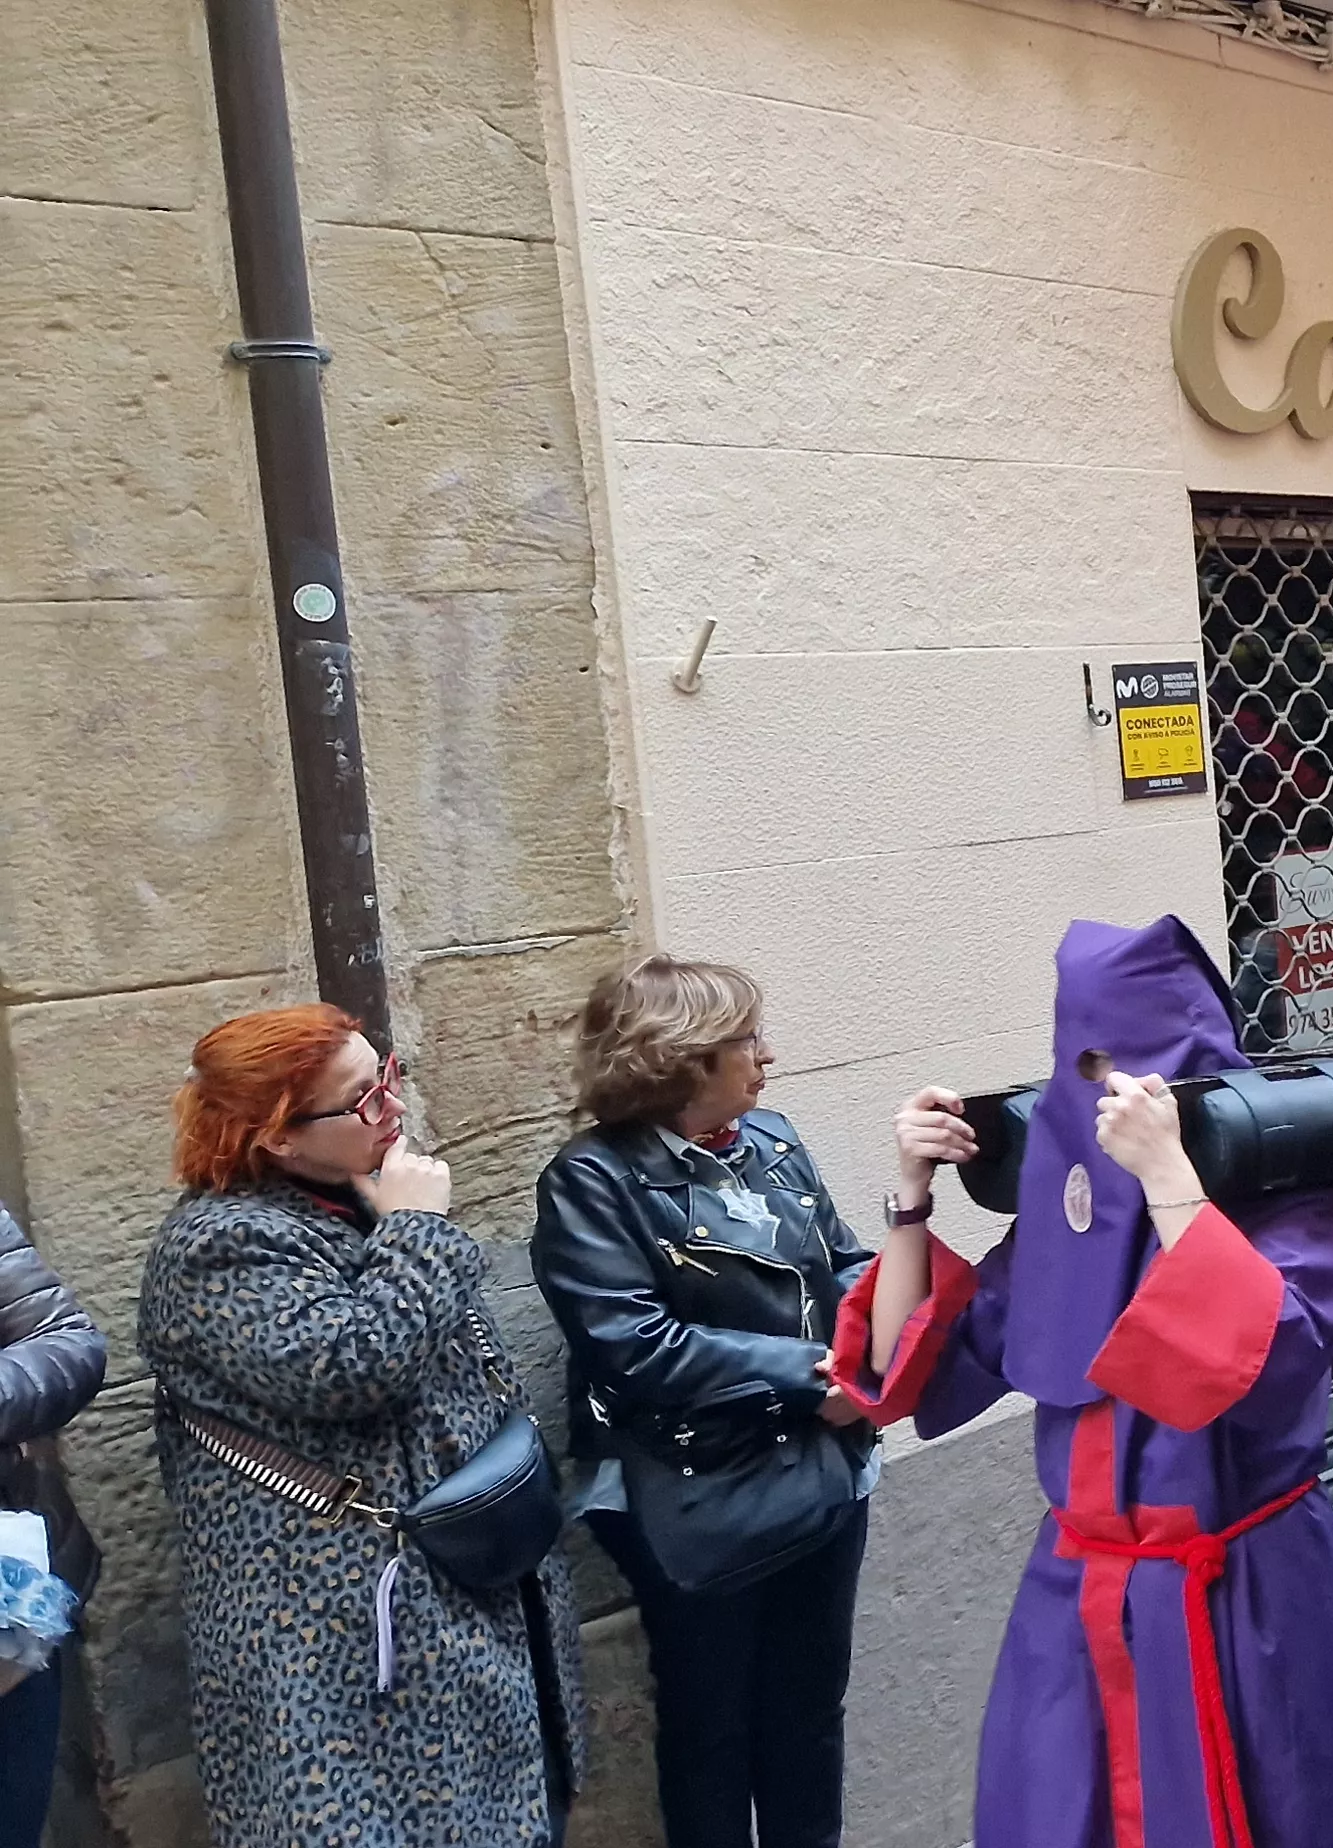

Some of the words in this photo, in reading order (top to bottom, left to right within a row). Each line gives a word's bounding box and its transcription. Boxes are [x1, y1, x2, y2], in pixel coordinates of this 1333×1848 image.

[1126, 715, 1194, 730] CONECTADA
[1127, 733, 1142, 741] CON
[1144, 731, 1164, 739] AVISO
[1165, 730, 1170, 738] A
